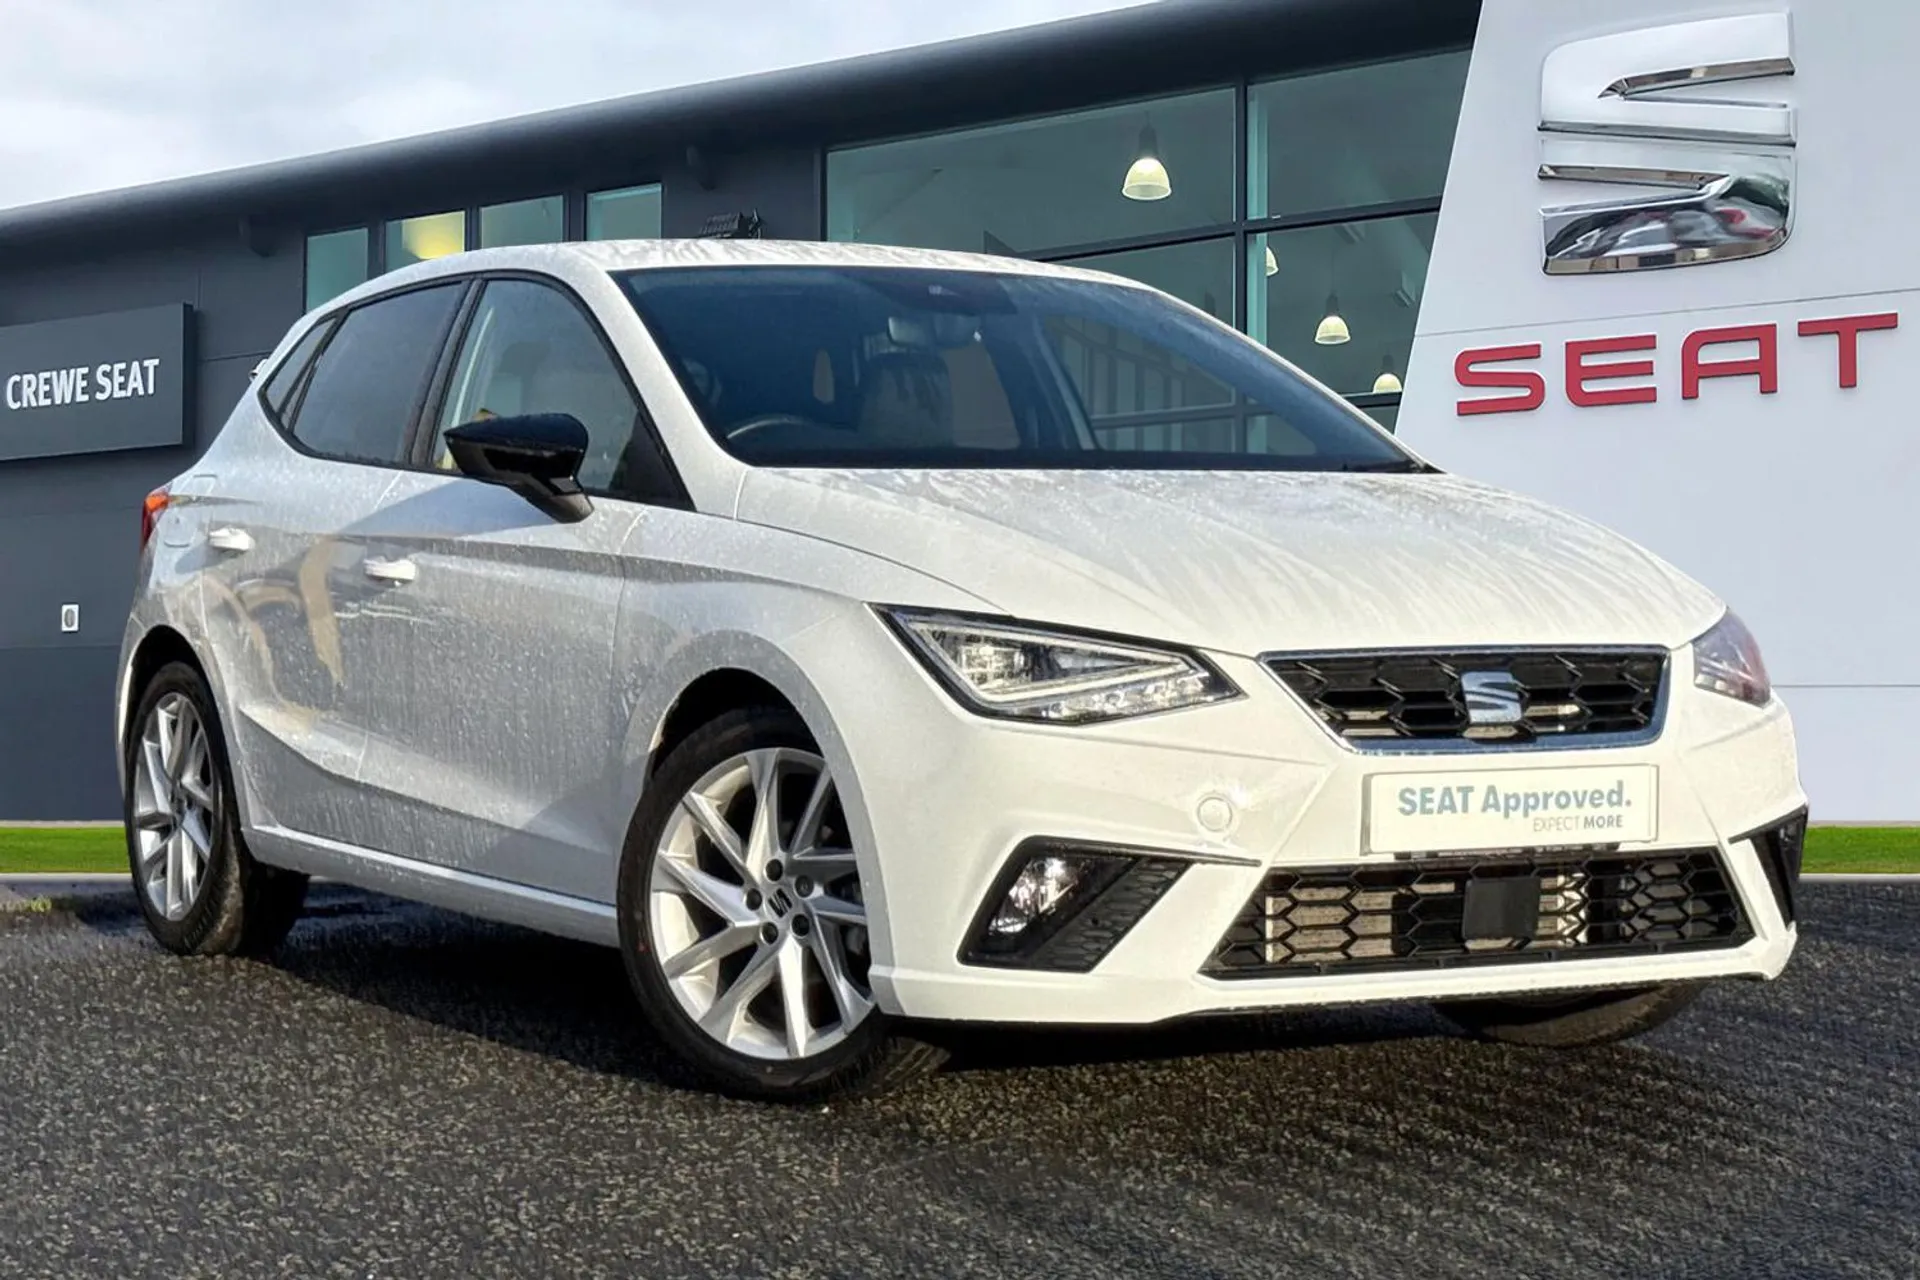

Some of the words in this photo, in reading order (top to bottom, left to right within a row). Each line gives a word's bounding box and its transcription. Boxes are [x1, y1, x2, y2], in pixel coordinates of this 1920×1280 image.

[6, 367, 90, 410] CREWE
[95, 358, 160, 401] SEAT
[1455, 312, 1899, 416] SEAT
[1398, 786, 1474, 816] SEAT
[1481, 780, 1632, 819] Approved.
[1532, 815, 1580, 832] EXPECT
[1583, 814, 1623, 829] MORE
